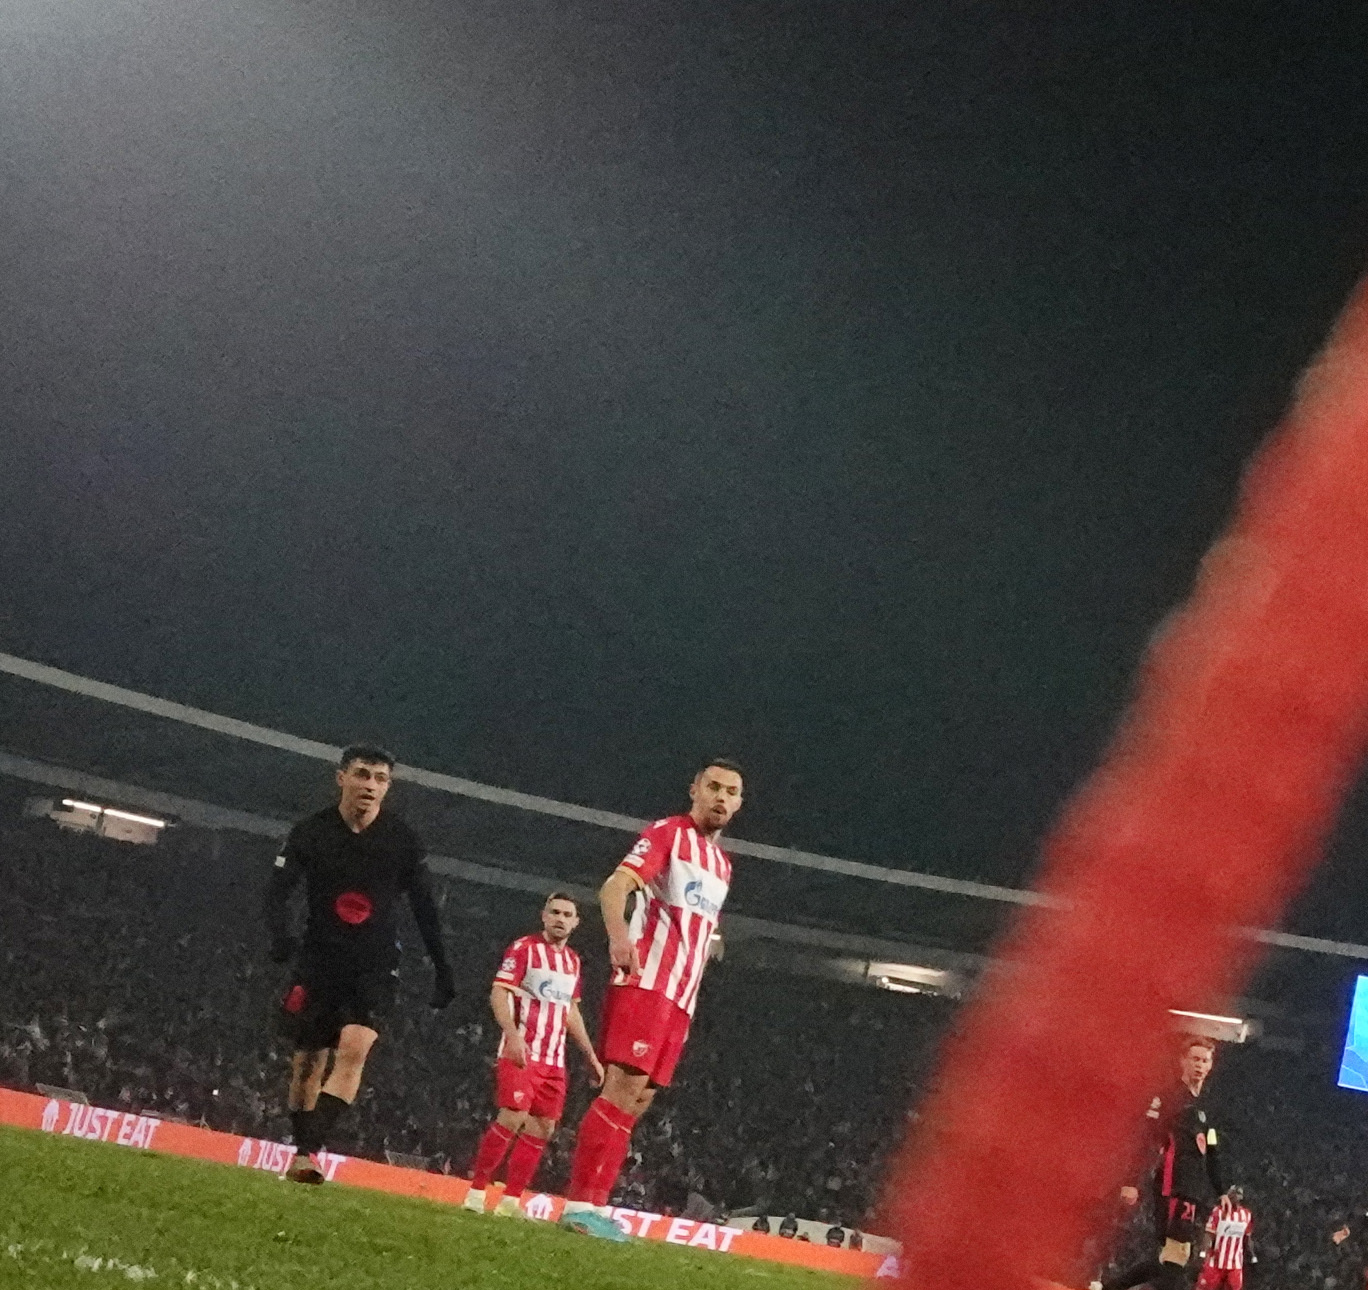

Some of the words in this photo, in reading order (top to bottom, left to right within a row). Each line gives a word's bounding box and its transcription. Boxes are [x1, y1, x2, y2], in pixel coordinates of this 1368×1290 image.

[62, 1102, 120, 1142] JUST
[117, 1112, 161, 1149] EAT
[252, 1138, 298, 1173] JUST
[664, 1217, 744, 1252] EAT
